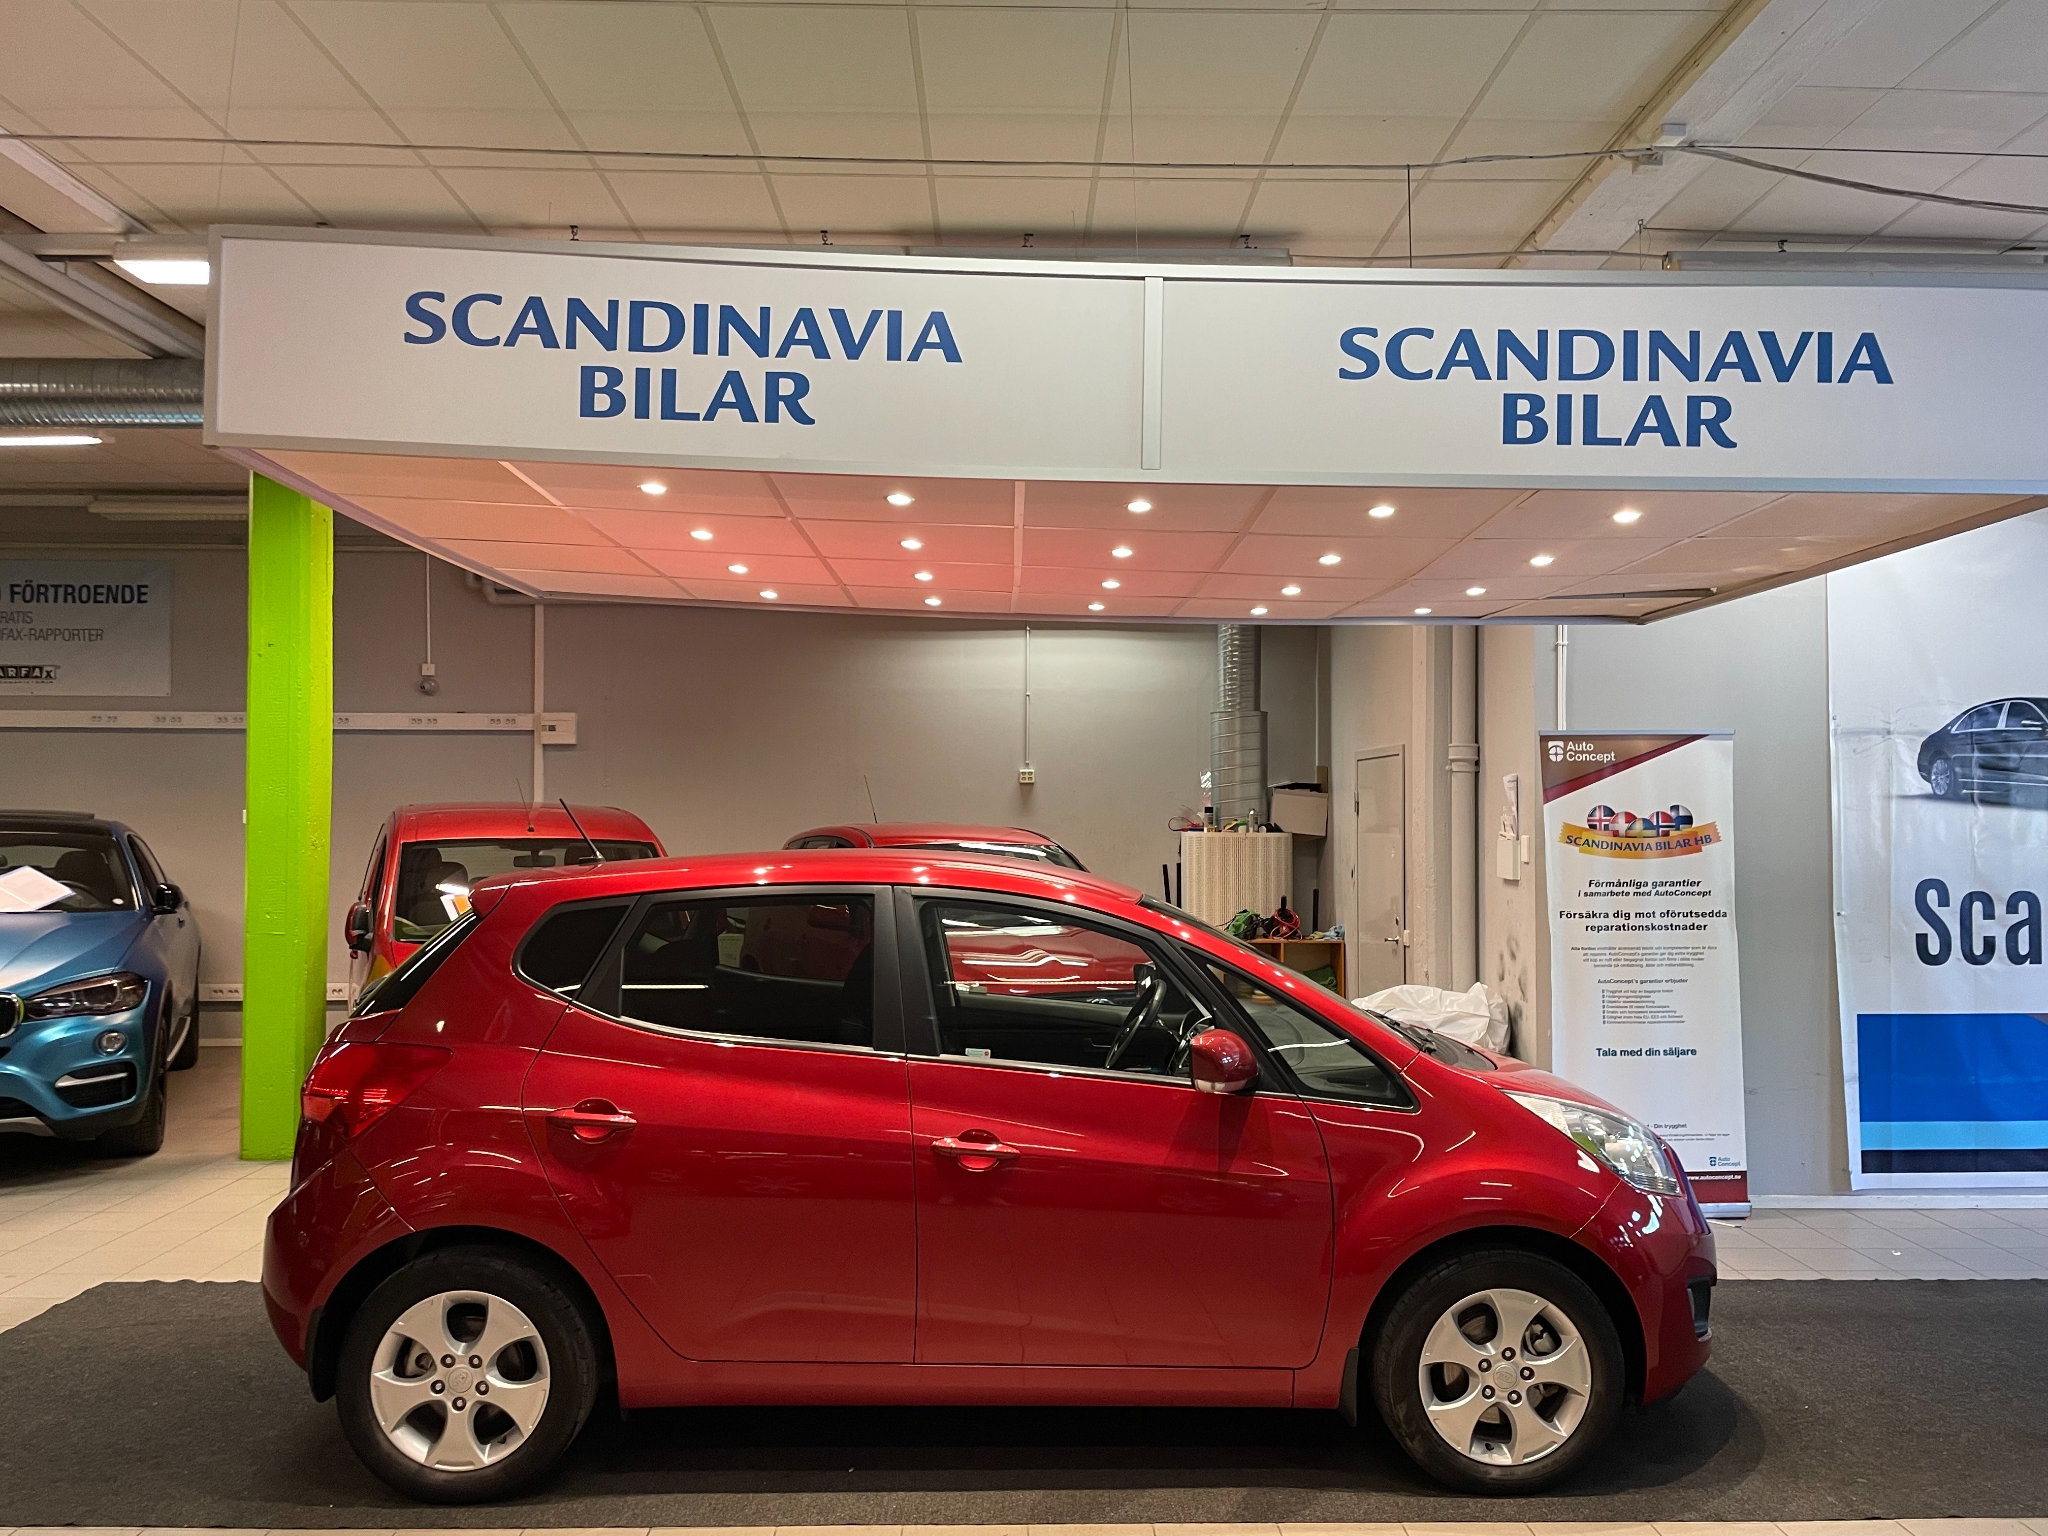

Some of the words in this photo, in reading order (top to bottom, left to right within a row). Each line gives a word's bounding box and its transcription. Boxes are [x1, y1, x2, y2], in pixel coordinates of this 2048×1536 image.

[403, 292, 962, 362] SCANDINAVIA
[1339, 327, 1893, 384] SCANDINAVIA
[581, 366, 814, 425] BILAR
[1503, 393, 1737, 449] BILAR
[9, 579, 149, 604] FÖRTROENDE
[1566, 741, 1594, 751] Auto
[1566, 751, 1616, 763] Concept
[1565, 835, 1654, 852] SCANDINAVIA
[1655, 836, 1692, 851] BILAR
[1694, 834, 1713, 846] HB
[1588, 879, 1649, 890] Förmånliga
[1651, 879, 1702, 890] garantier
[1653, 889, 1712, 898] AutoConcept
[1559, 910, 1609, 919] Försäkra
[1612, 910, 1631, 920] dig
[1634, 911, 1656, 919] mot
[1659, 909, 1728, 919] oförutsedda
[1585, 922, 1708, 933] reparationskostnader
[1914, 878, 2043, 967] Sca
[1596, 1047, 1617, 1056] Tala
[1619, 1047, 1642, 1056] med
[1645, 1047, 1660, 1056] din
[1662, 1046, 1697, 1058] säljare
